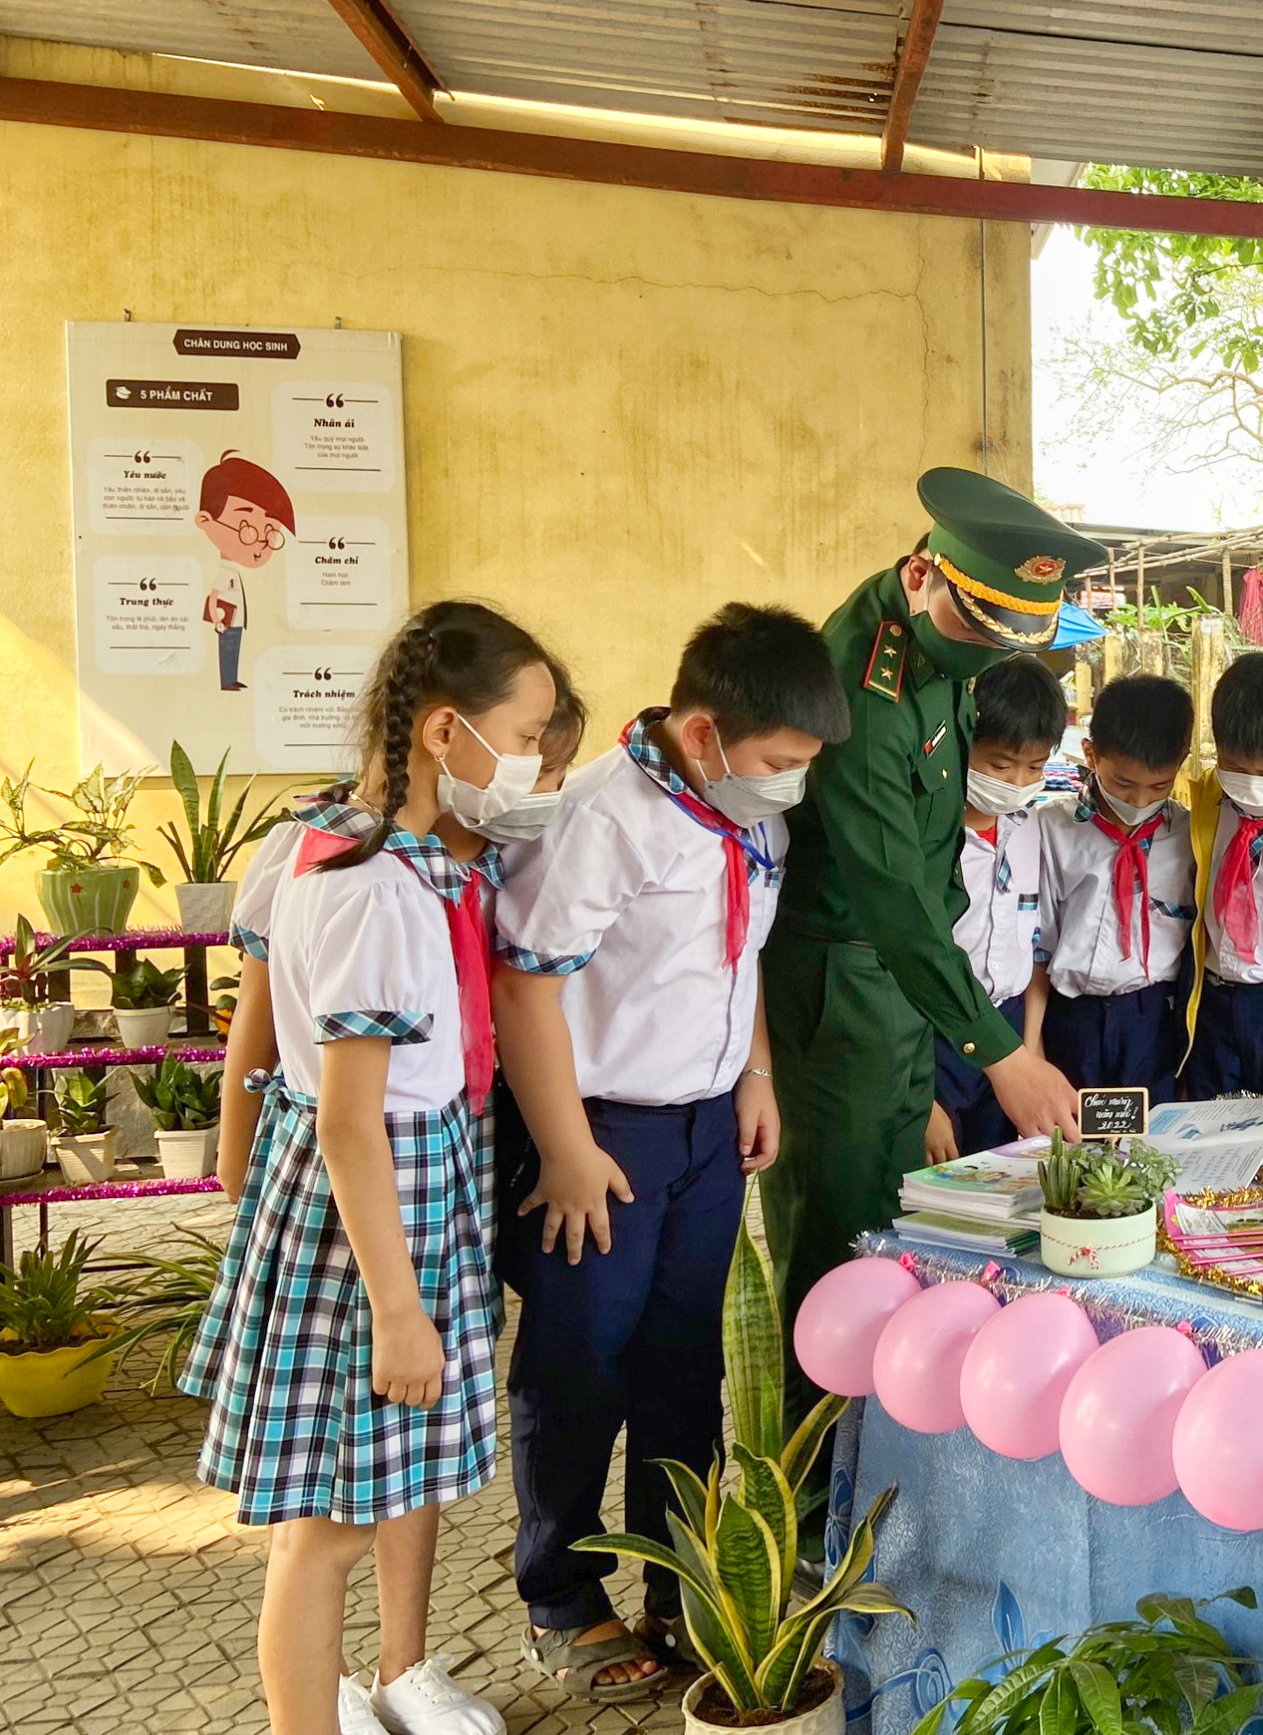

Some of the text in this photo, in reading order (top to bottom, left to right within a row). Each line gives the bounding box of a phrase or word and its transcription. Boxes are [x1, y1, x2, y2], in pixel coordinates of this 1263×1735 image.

[184, 337, 288, 351] CHÂN DUNG HỌC SINH
[140, 385, 213, 401] 5 PHẨM CHẤT
[314, 418, 355, 428] Nhân ái
[124, 470, 166, 479] Yêu nước
[315, 556, 359, 564] Chăm chỉ
[120, 597, 174, 608] Trung thực
[293, 689, 355, 701] Trách nhiệm
